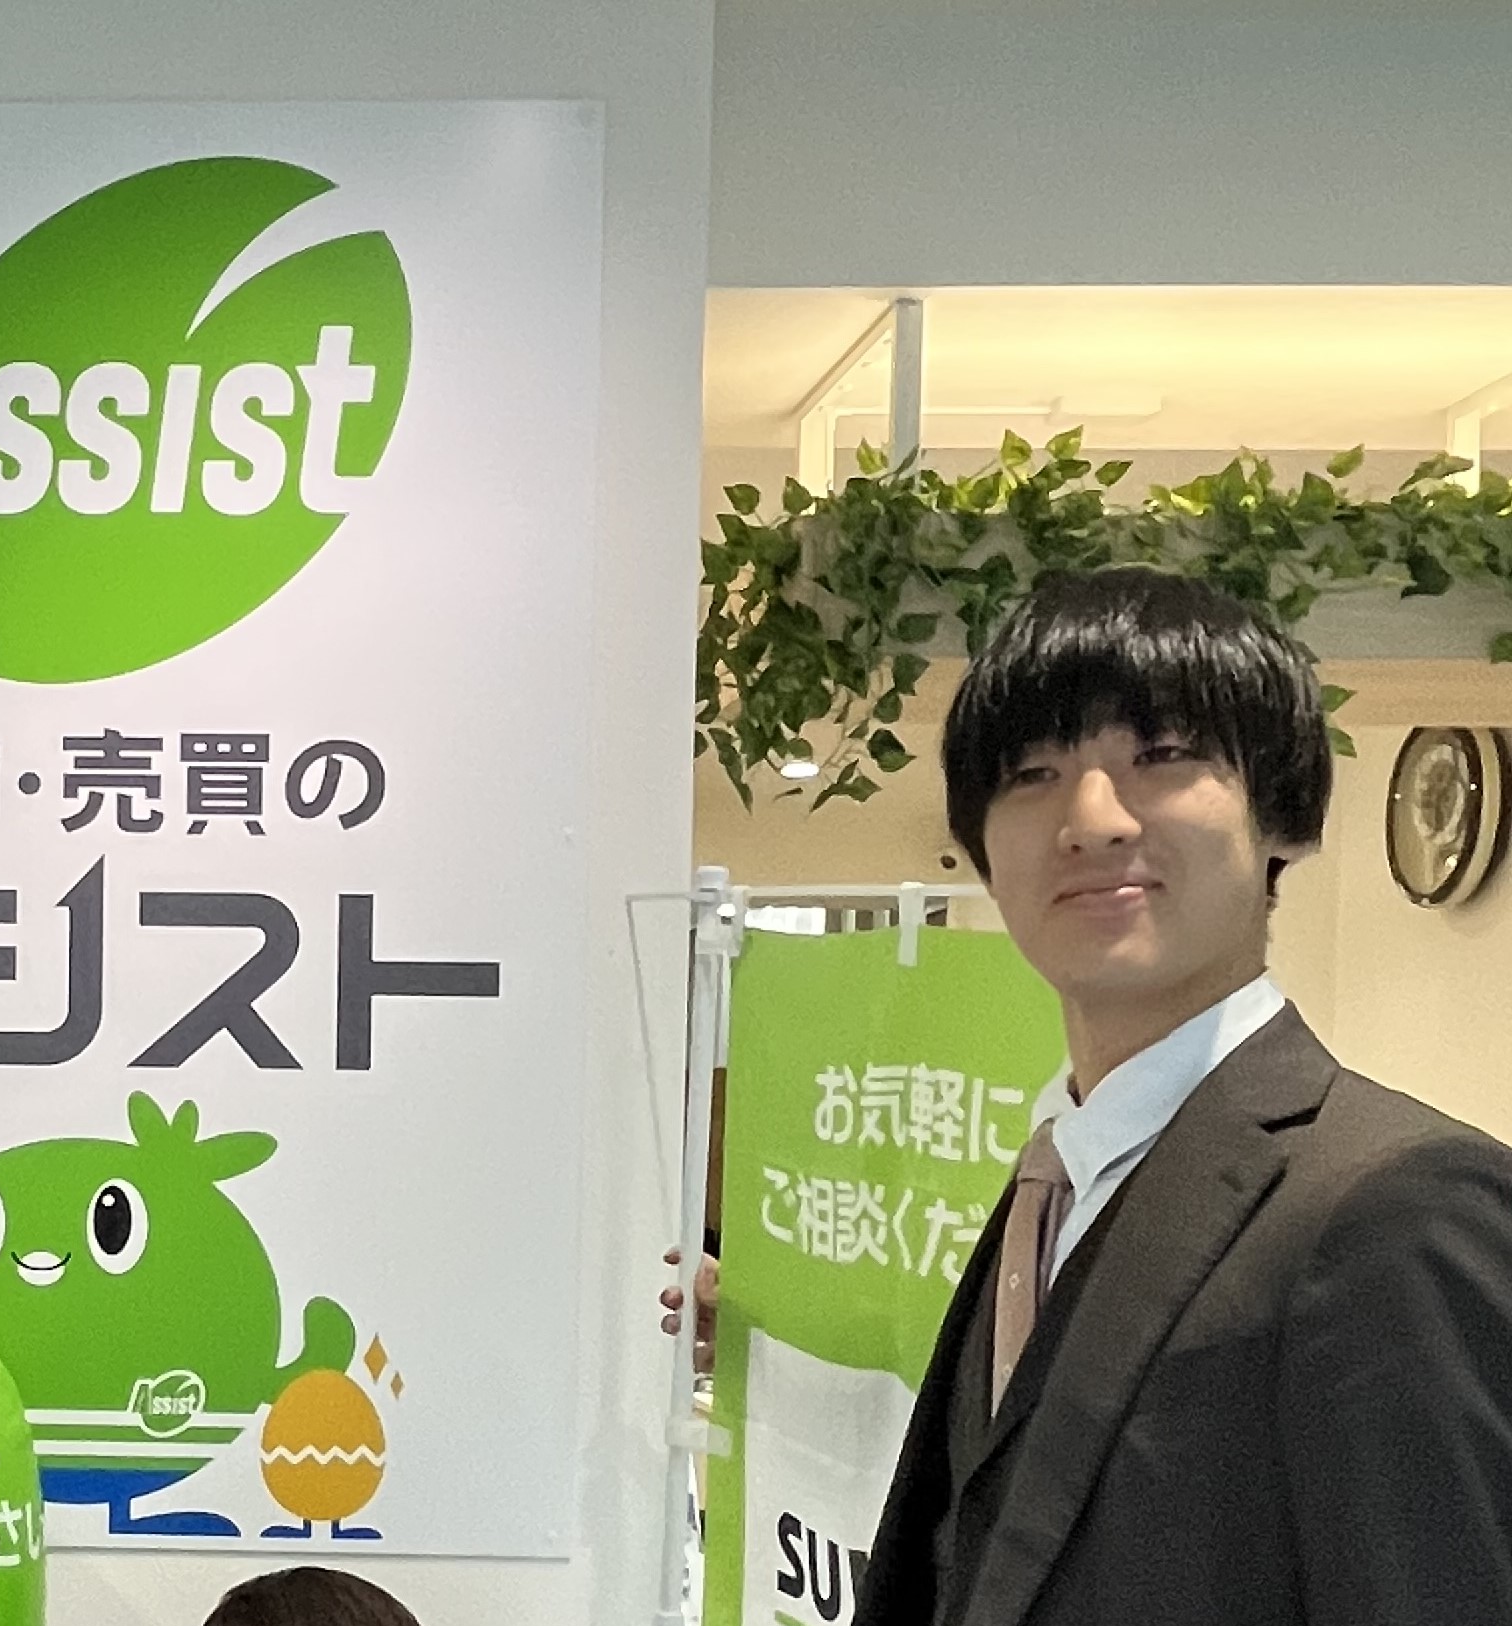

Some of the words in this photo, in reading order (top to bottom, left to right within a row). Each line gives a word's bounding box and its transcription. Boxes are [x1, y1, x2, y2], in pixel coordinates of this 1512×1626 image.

[813, 1062, 1025, 1165] お気軽に
[776, 1511, 866, 1622] SU
